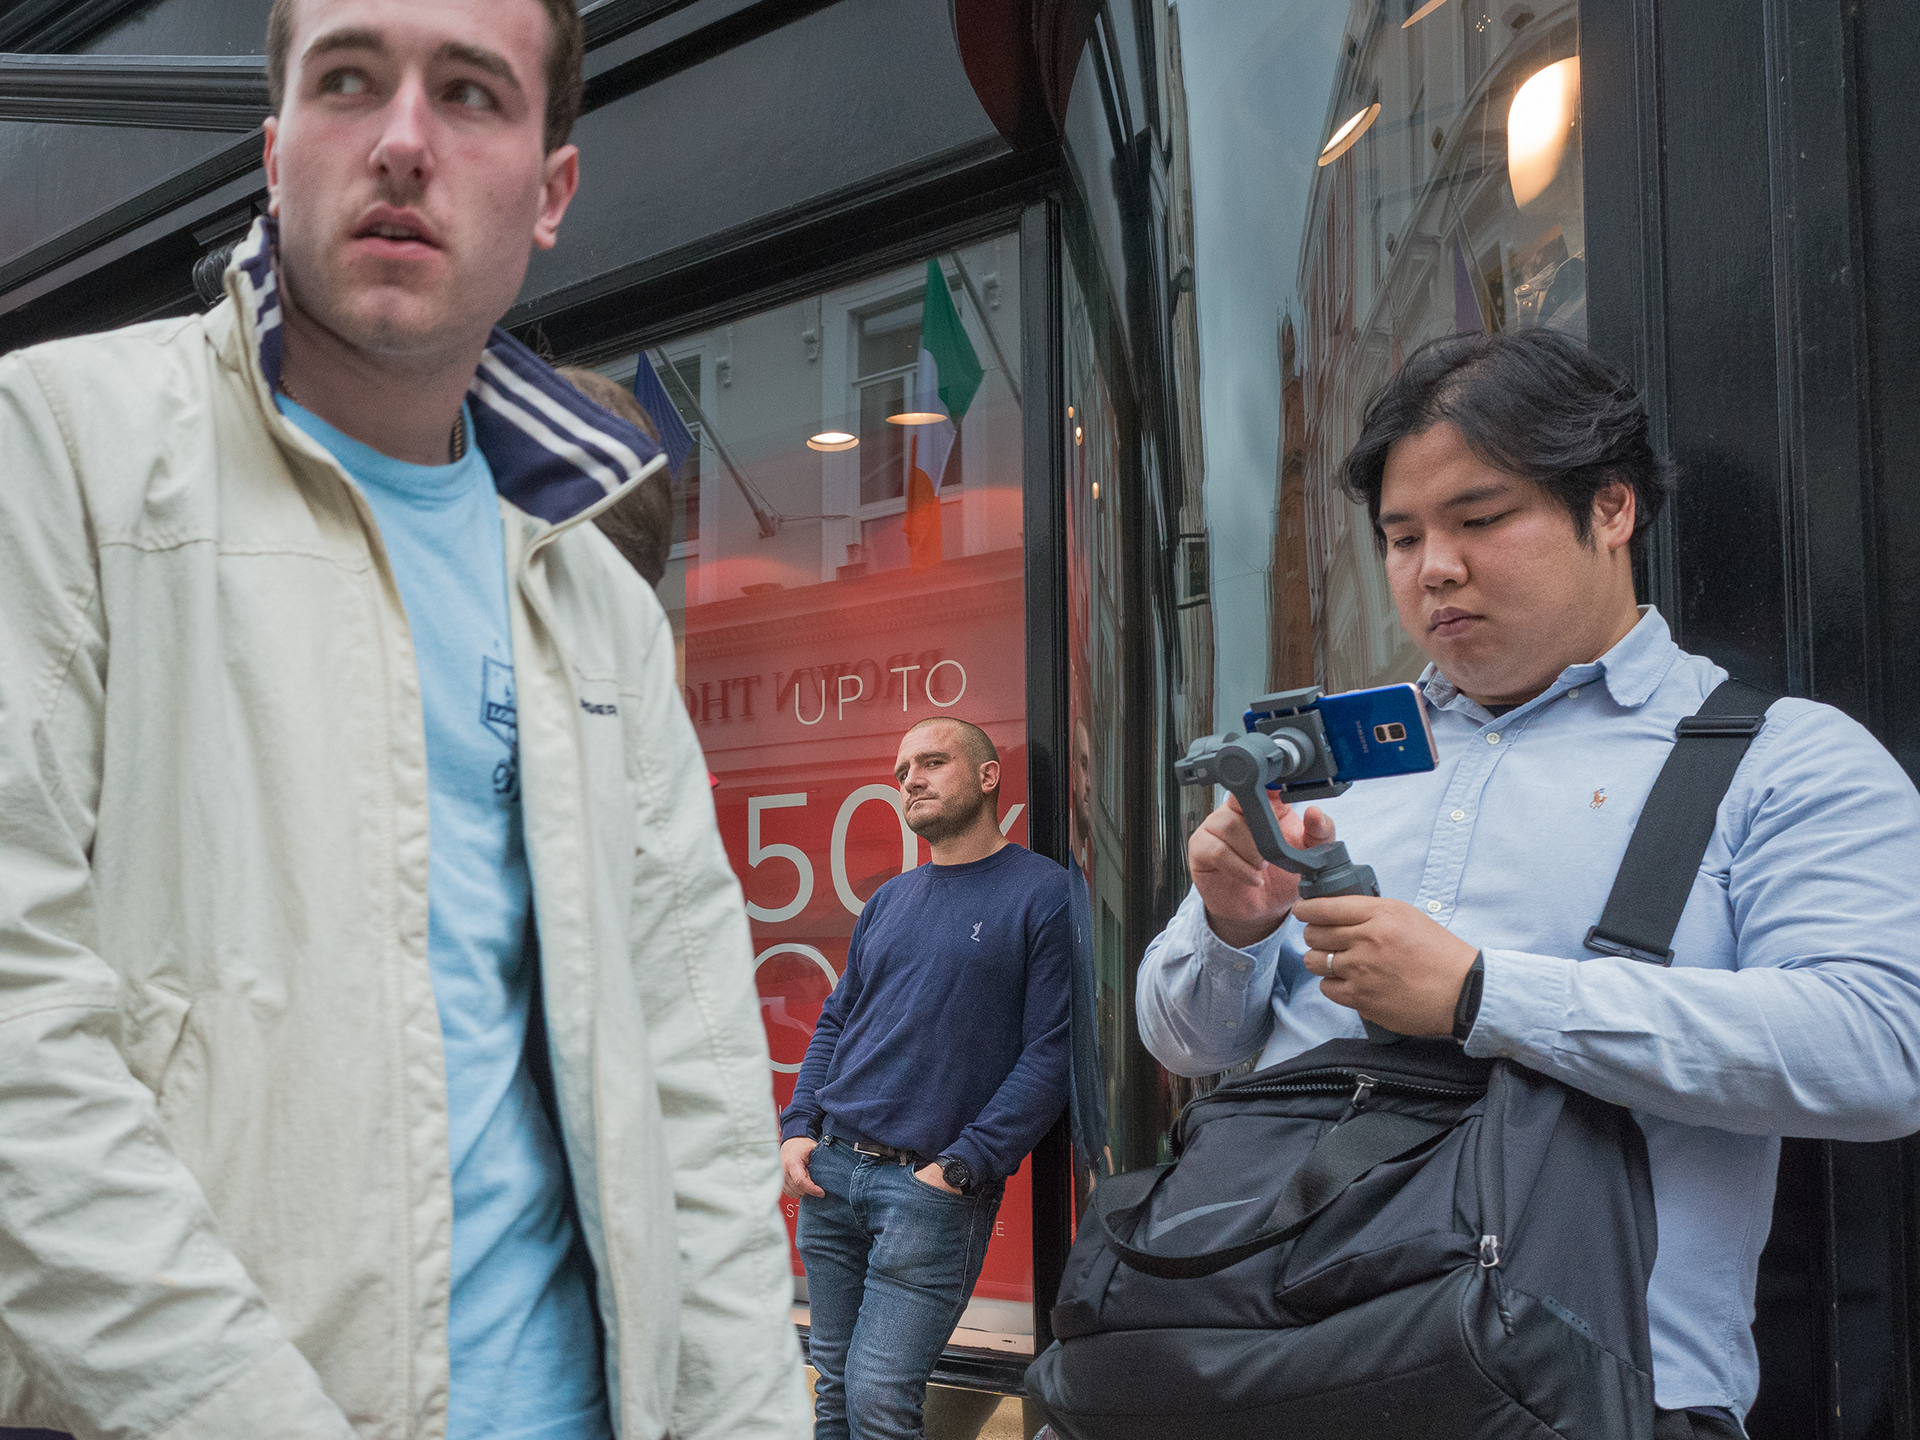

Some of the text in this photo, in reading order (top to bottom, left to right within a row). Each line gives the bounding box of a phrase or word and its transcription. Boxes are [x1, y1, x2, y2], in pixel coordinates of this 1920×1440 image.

[794, 659, 967, 726] UP TO
[745, 783, 1026, 923] 50
